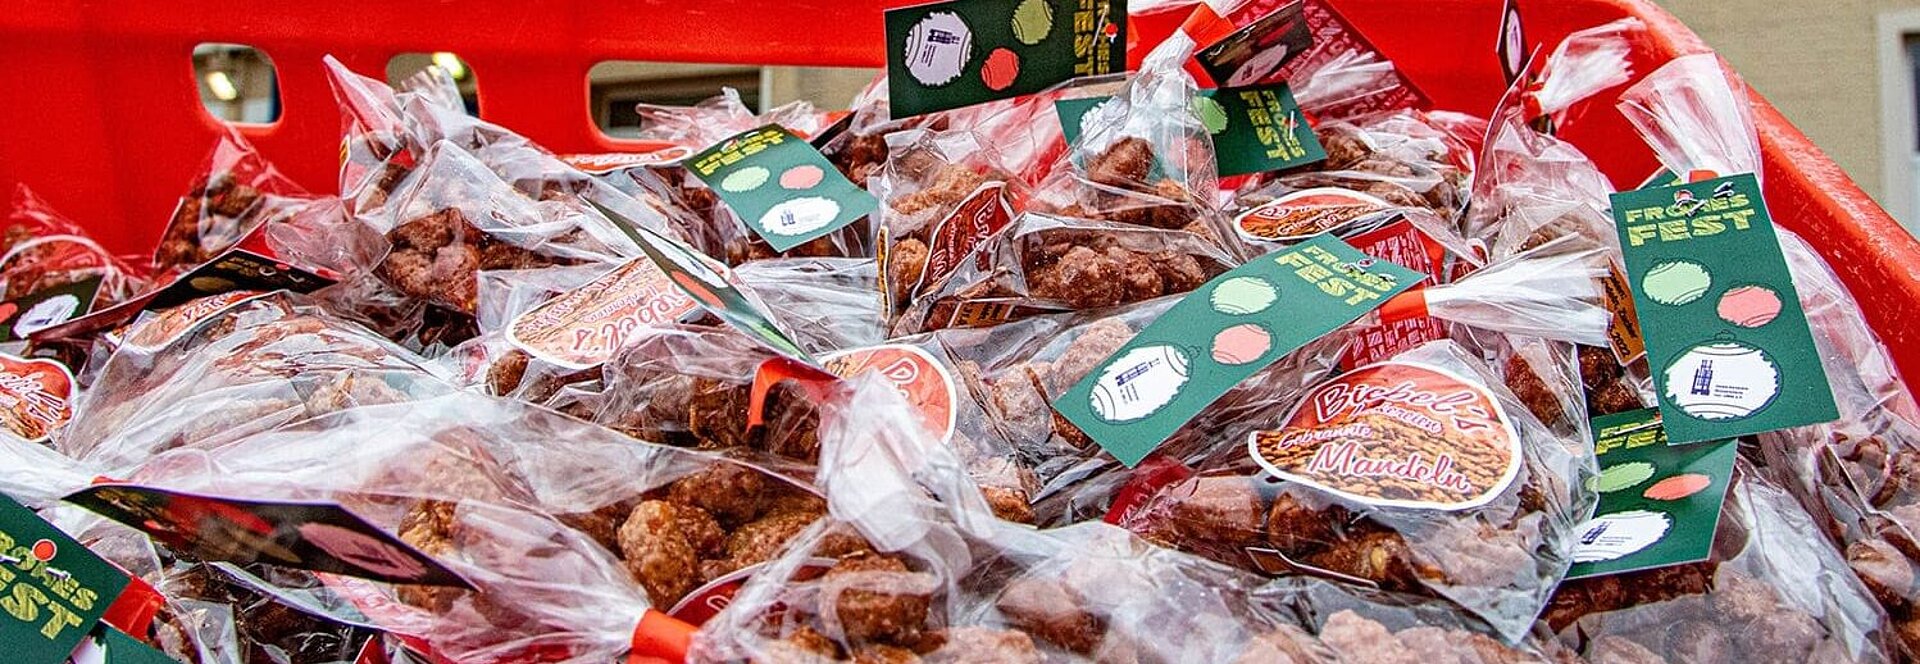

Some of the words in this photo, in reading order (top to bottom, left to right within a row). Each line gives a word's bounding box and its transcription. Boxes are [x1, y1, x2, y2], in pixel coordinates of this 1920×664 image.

[1240, 91, 1291, 161] FEST
[699, 133, 784, 176] FEST
[1627, 208, 1755, 247] FEST
[1274, 251, 1381, 306] FEST
[1278, 421, 1373, 450] Gebrannte
[1309, 440, 1472, 494] Mandeln
